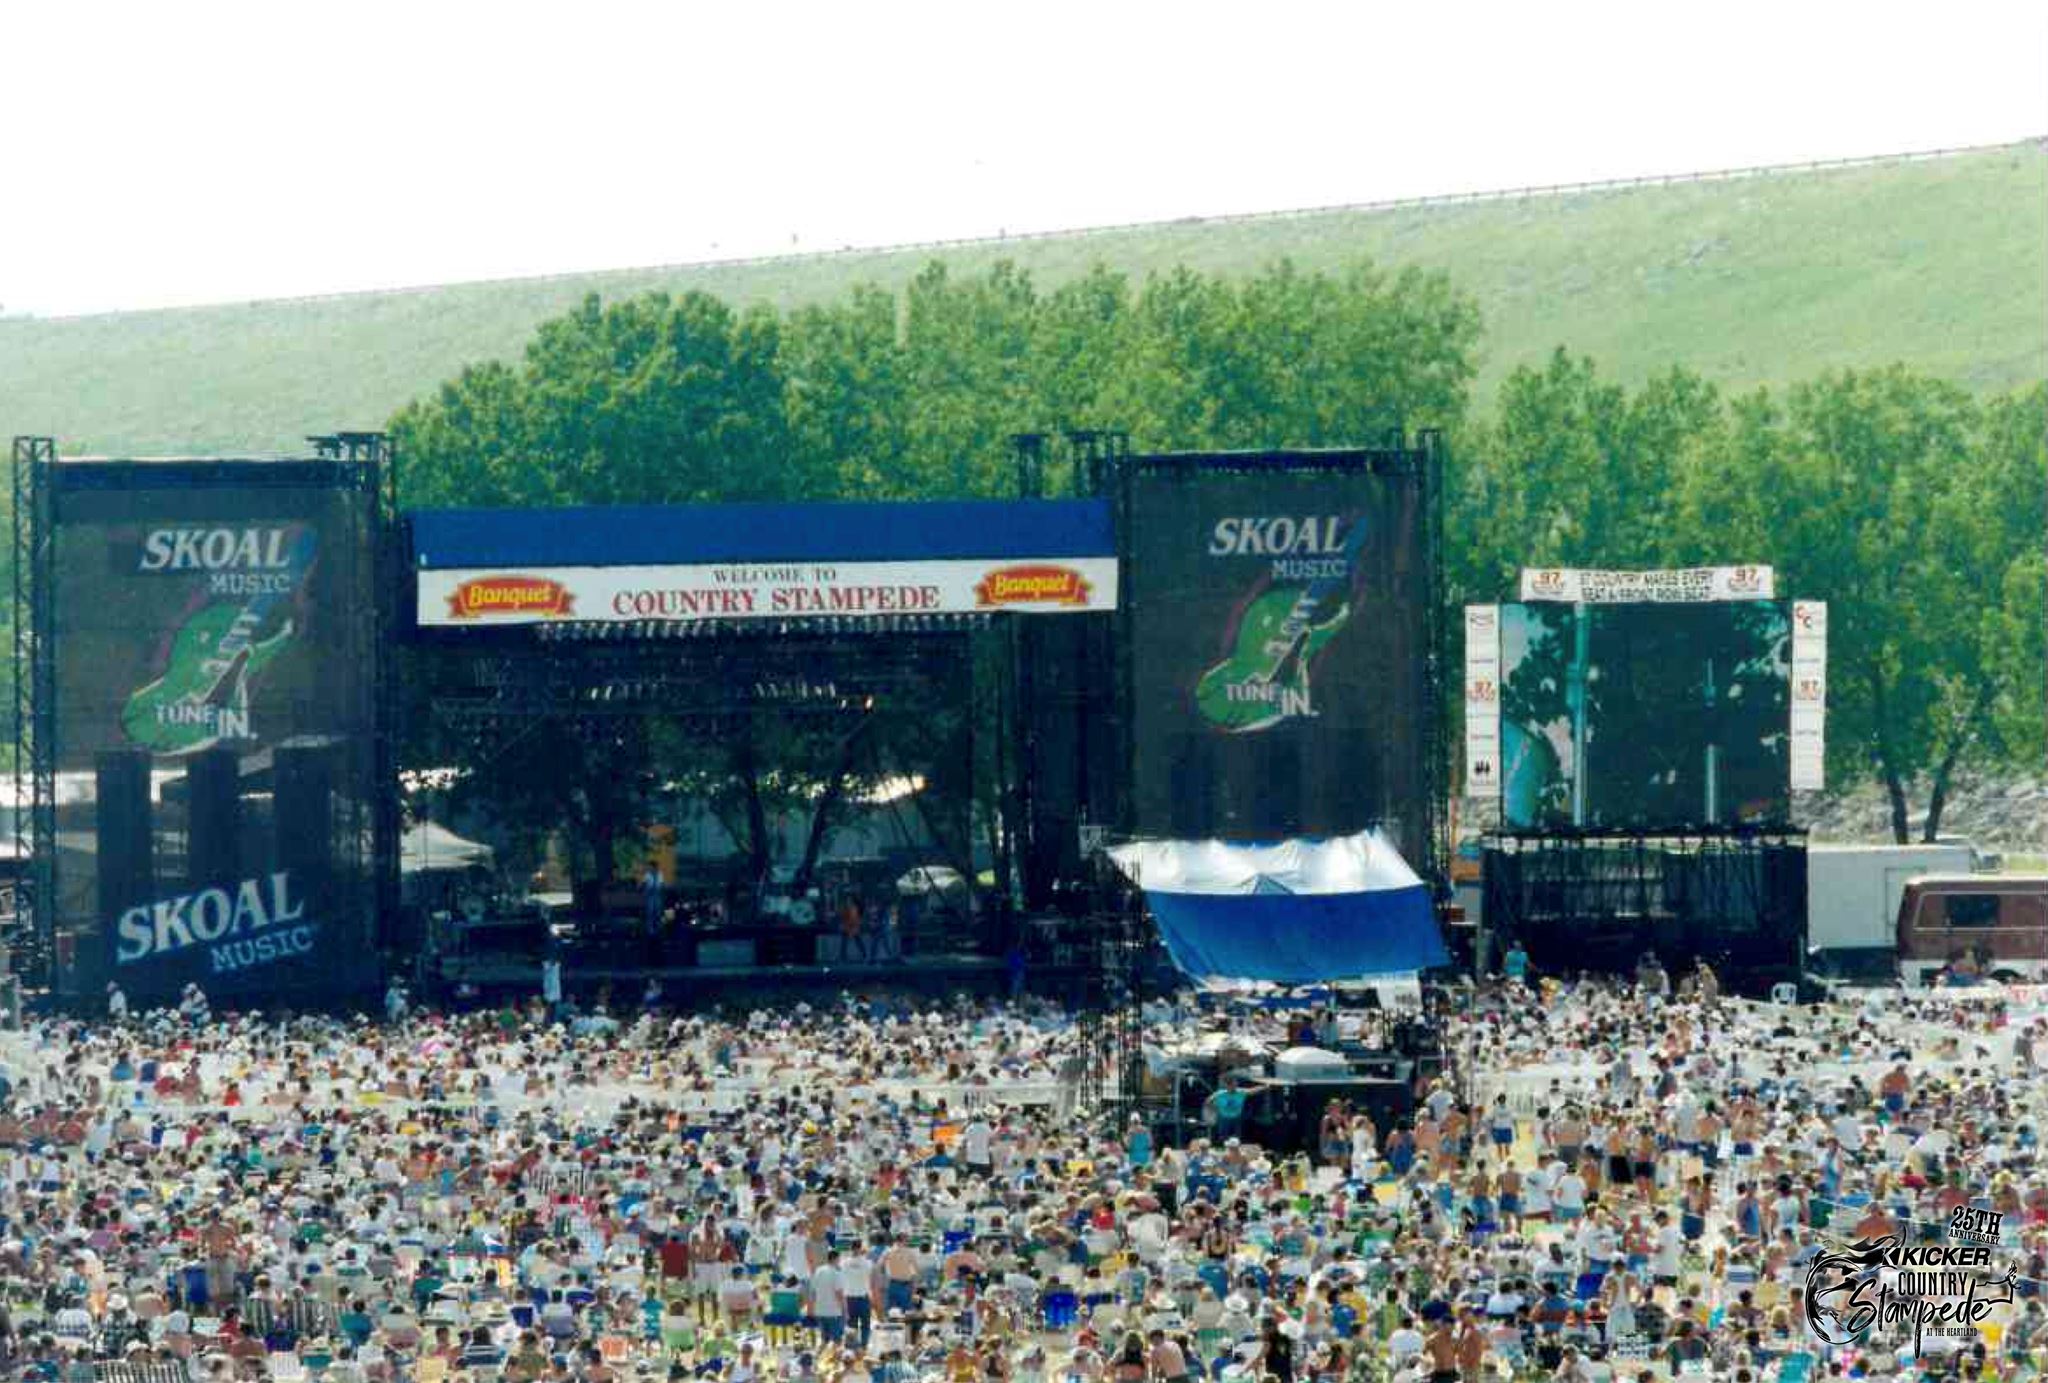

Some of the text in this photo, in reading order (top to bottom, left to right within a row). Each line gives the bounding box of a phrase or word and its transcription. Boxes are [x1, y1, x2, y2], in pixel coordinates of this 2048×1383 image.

[1208, 516, 1349, 555] SKOAL
[139, 528, 291, 571] SKOAL
[713, 567, 837, 584] WELCOME TO
[1271, 559, 1347, 578] MUSIC
[210, 573, 291, 594] MUSIC
[469, 583, 552, 609] Banquet
[995, 573, 1070, 599] Banquet
[612, 585, 940, 615] COUNTRY STAMPEDE
[1224, 682, 1281, 701] TUNE
[154, 703, 217, 725] TUNE
[117, 872, 305, 964] SKOAL
[211, 924, 314, 973] MUSIC
